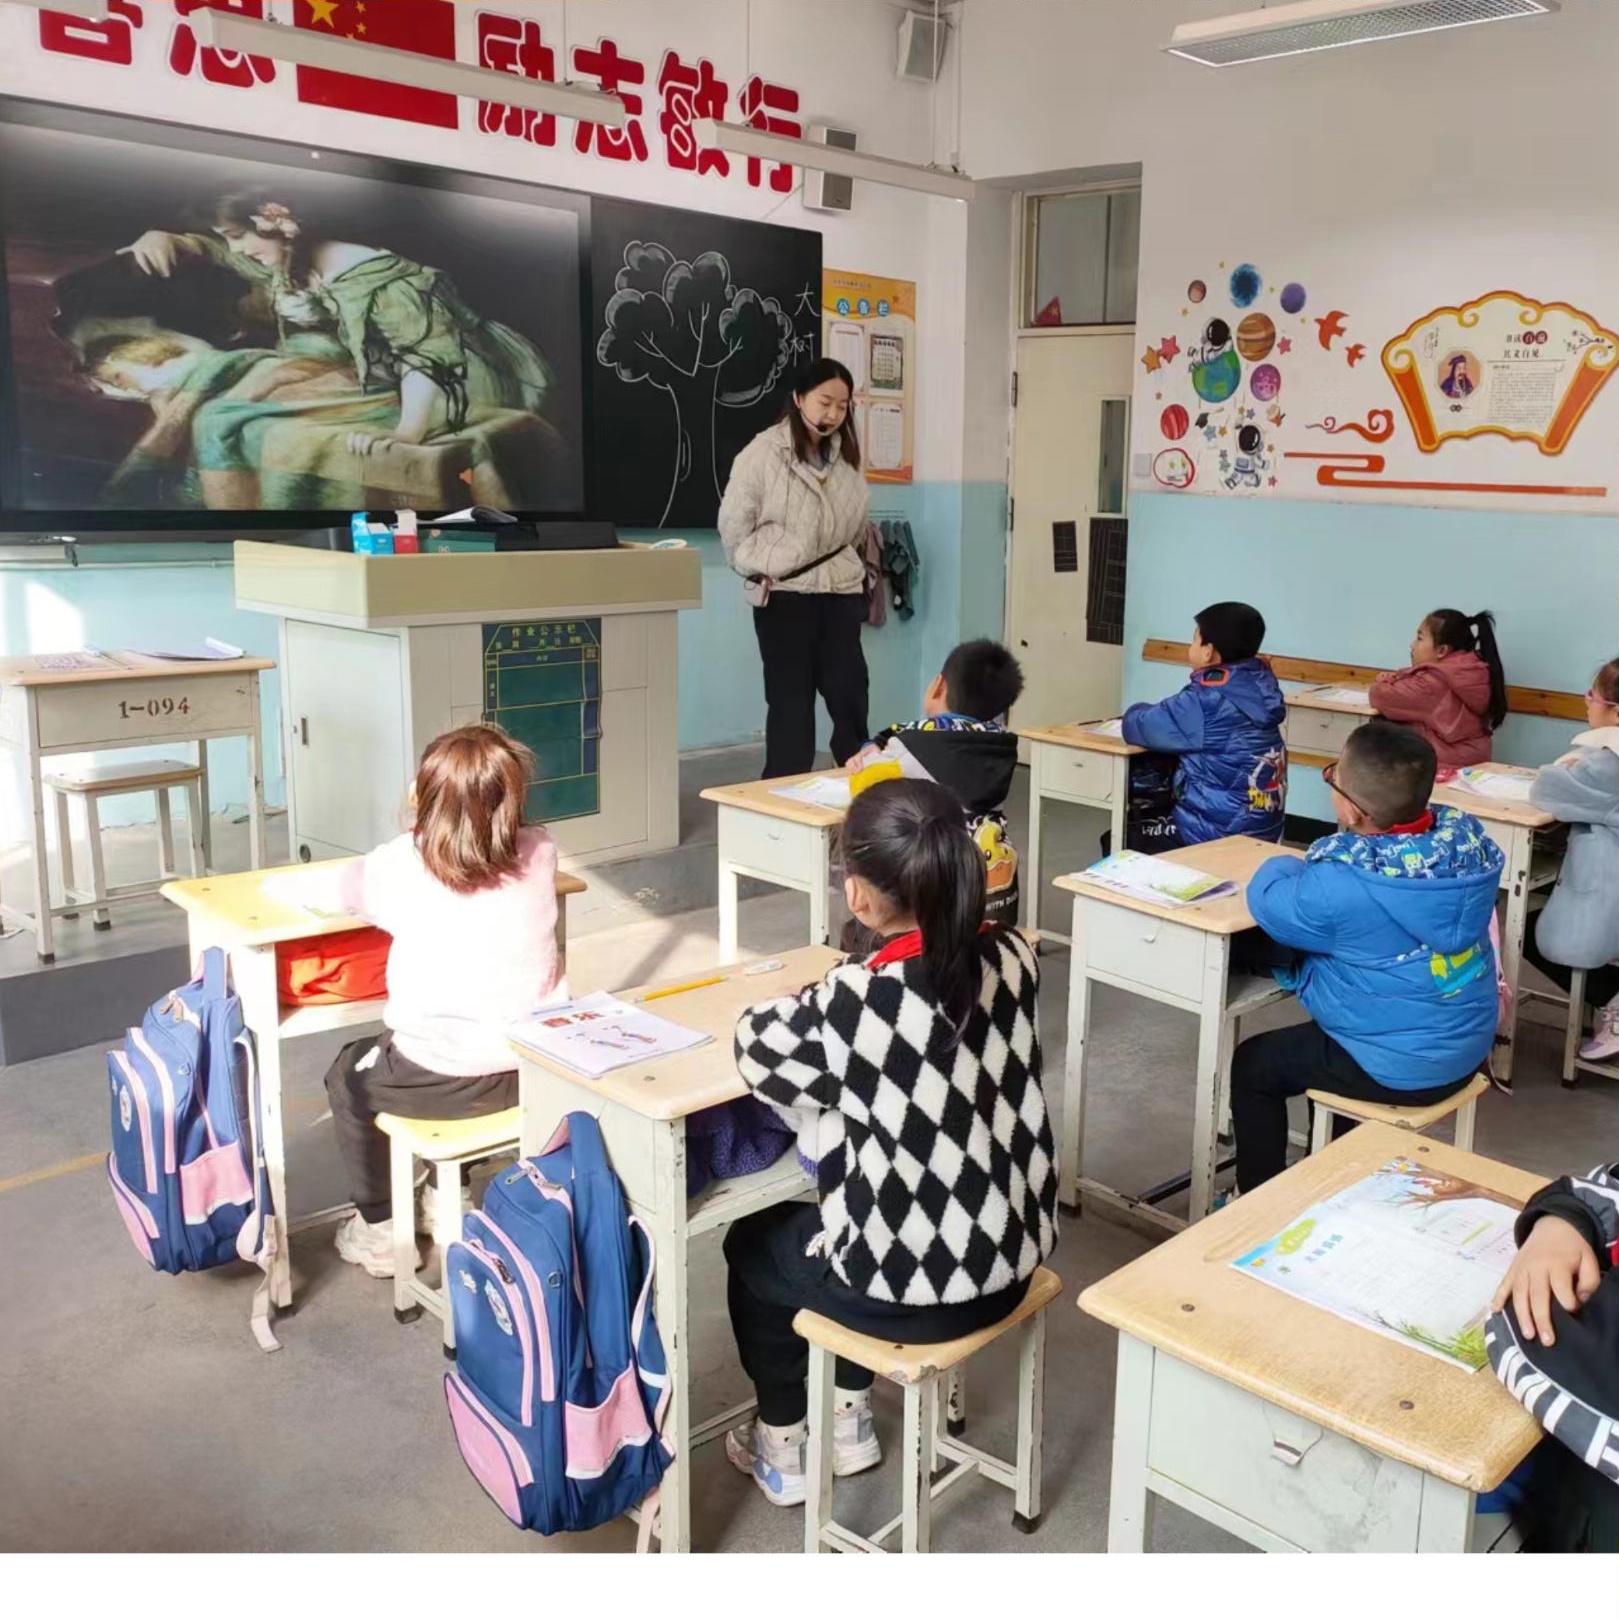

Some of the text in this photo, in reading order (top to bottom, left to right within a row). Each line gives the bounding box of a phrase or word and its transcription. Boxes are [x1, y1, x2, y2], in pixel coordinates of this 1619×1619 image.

[476, 11, 802, 194] 励志敏行
[837, 300, 889, 317] 公告栏
[789, 282, 821, 368] 大树
[511, 624, 577, 638] 作业公示栏
[118, 696, 191, 719] 1-094
